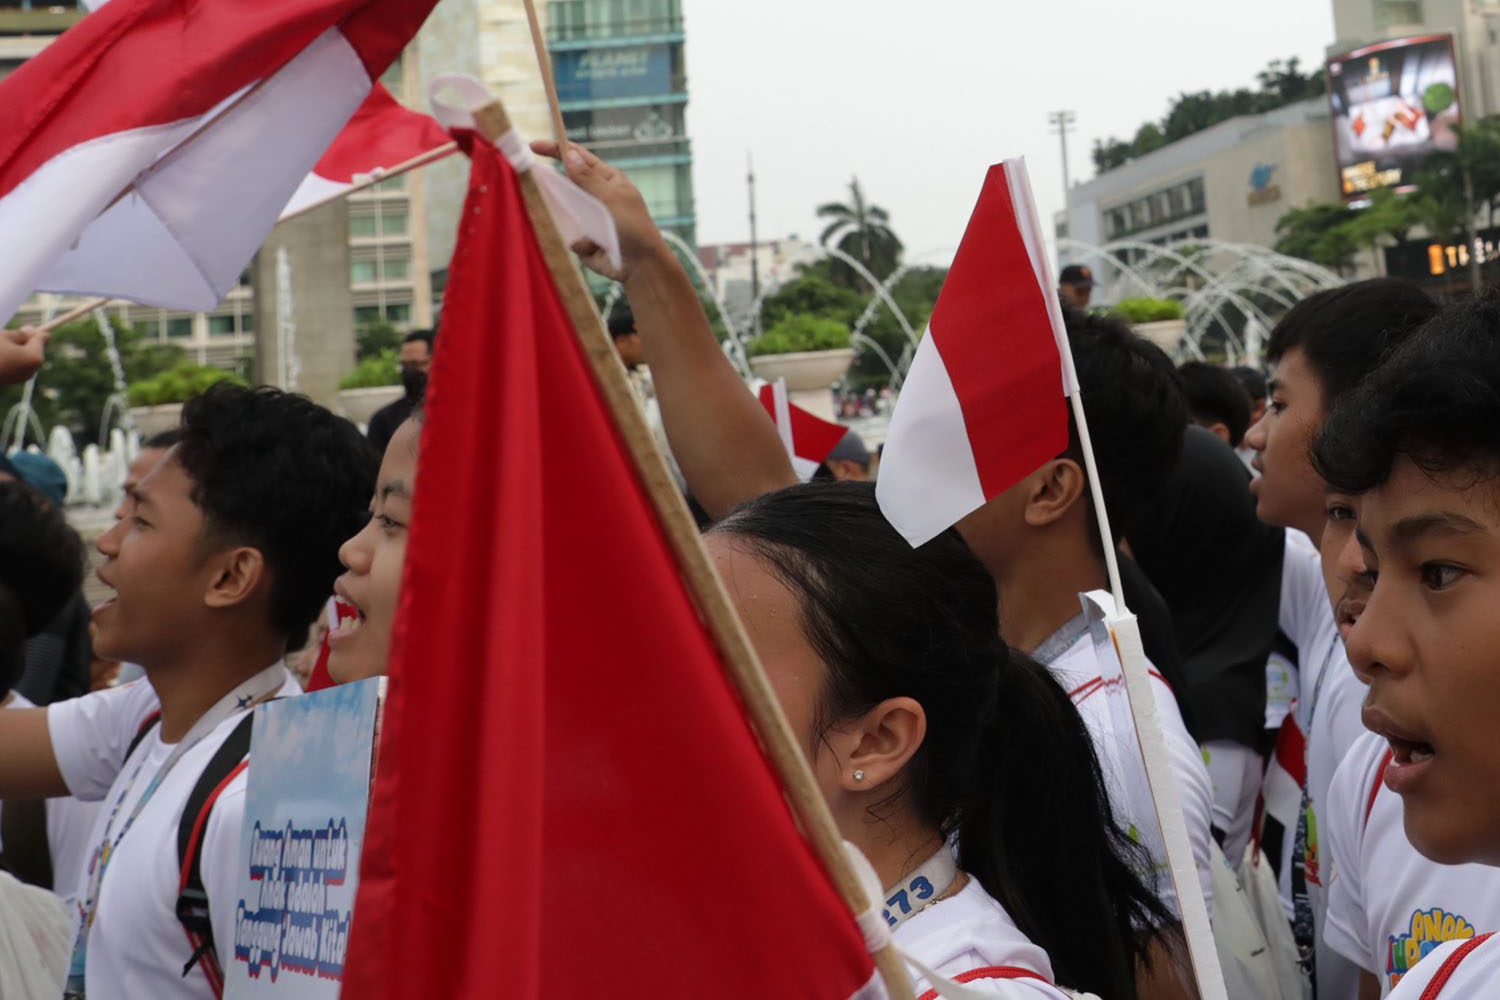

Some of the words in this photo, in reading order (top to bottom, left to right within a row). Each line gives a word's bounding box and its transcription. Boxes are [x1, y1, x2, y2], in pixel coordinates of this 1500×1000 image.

[282, 827, 313, 869] Aman
[313, 825, 346, 870] untuk
[261, 869, 285, 910] Anak
[286, 871, 325, 916] adalah
[236, 906, 281, 969] Tanggung
[281, 912, 318, 961] Jawab
